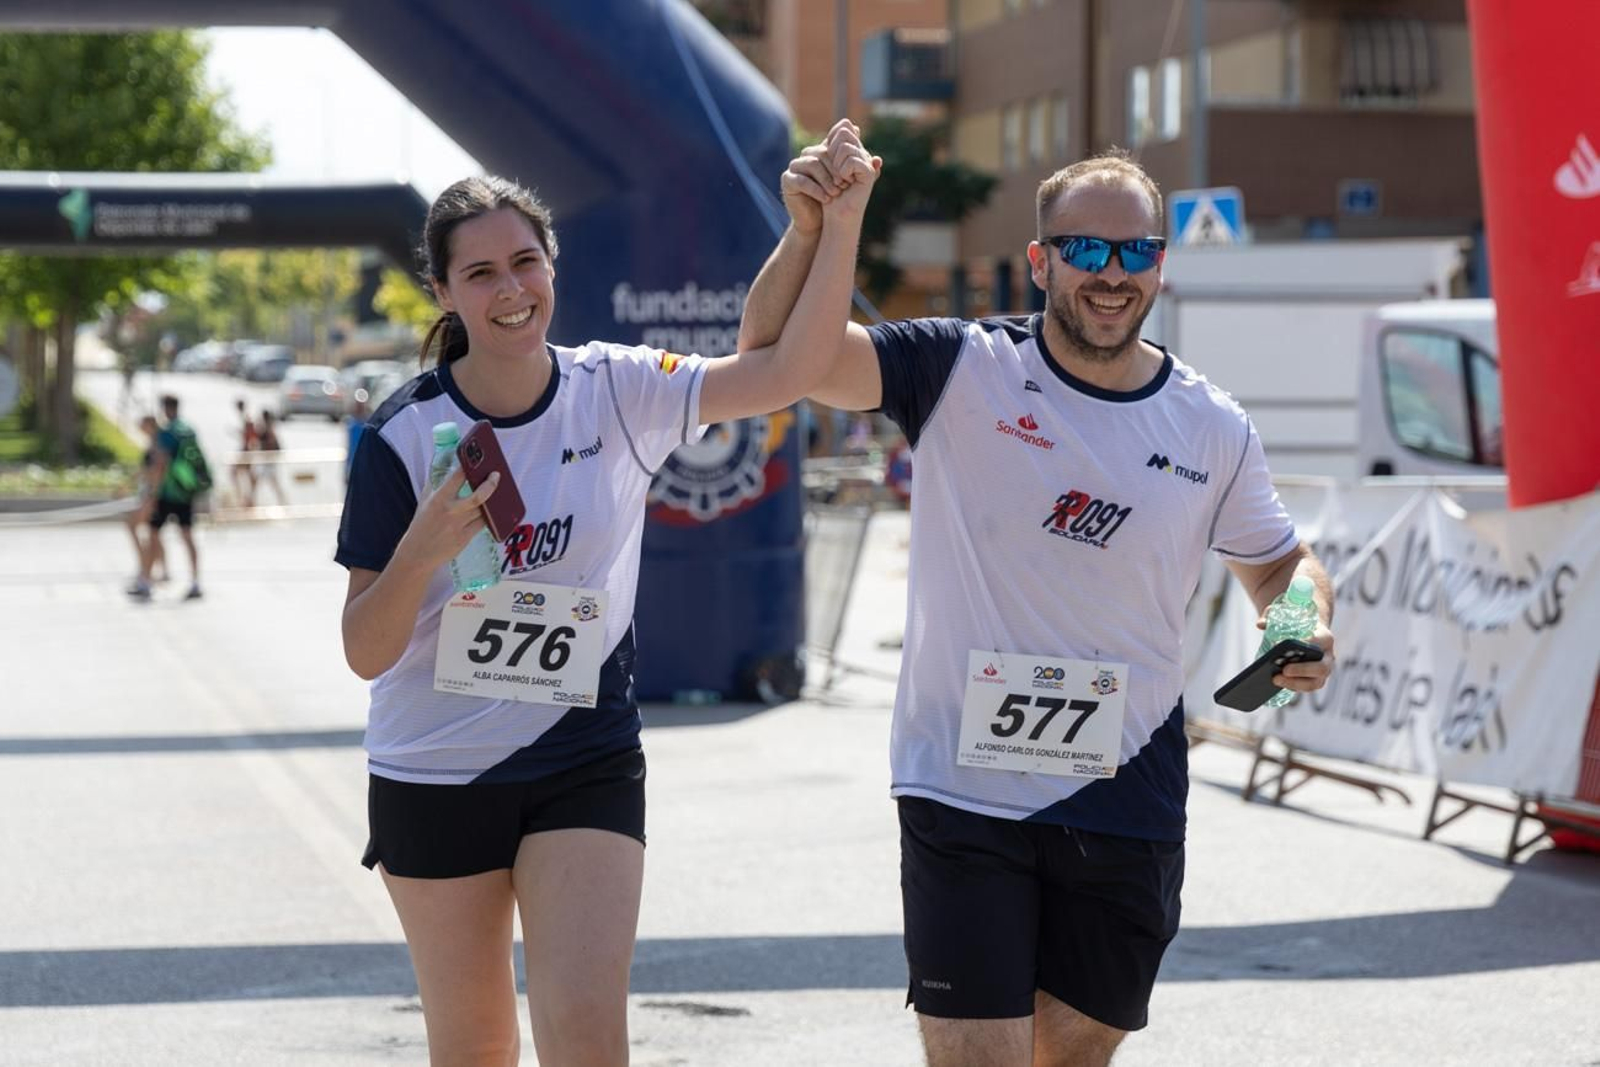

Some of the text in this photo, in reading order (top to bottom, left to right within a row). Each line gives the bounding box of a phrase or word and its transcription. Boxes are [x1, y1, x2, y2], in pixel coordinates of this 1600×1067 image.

[612, 281, 747, 324] fundaci
[643, 326, 739, 357] mup
[996, 420, 1056, 450] Santander
[1174, 464, 1209, 485] mupol
[467, 618, 576, 671] 576
[472, 671, 562, 688] ALBA CAPARRÓS SÁNCHEZ
[990, 693, 1100, 744] 577
[974, 742, 1006, 752] ALFONSO
[1007, 745, 1034, 755] CARLOS
[1035, 747, 1070, 759] GONZÁLEZ
